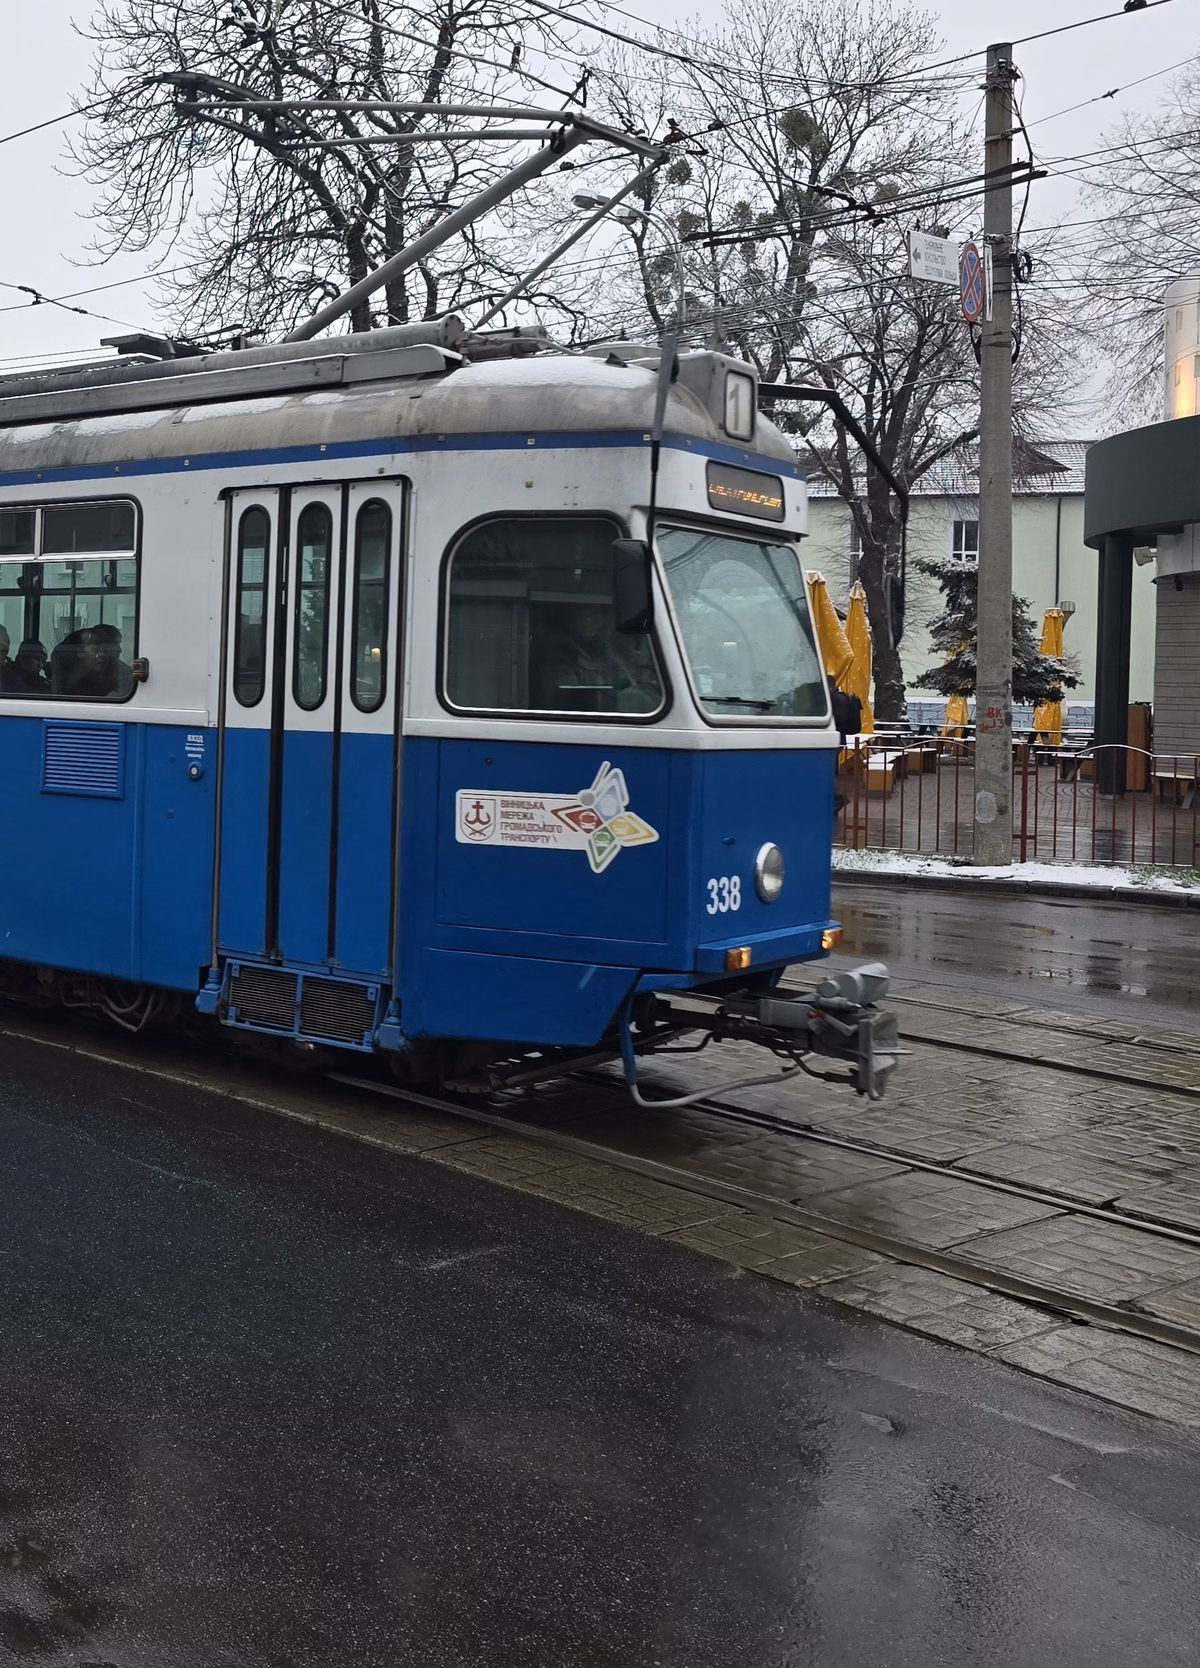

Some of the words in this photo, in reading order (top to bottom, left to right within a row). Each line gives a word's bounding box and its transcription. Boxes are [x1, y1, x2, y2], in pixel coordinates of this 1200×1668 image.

[728, 383, 740, 431] 1
[500, 800, 546, 811] ВІННИЦЬКА
[500, 811, 535, 821] МЕРЕЖА
[500, 821, 563, 834] ГРОМАДСЬКОГО
[500, 832, 552, 844] ТРАНСПОРТУ
[706, 875, 741, 915] 338
